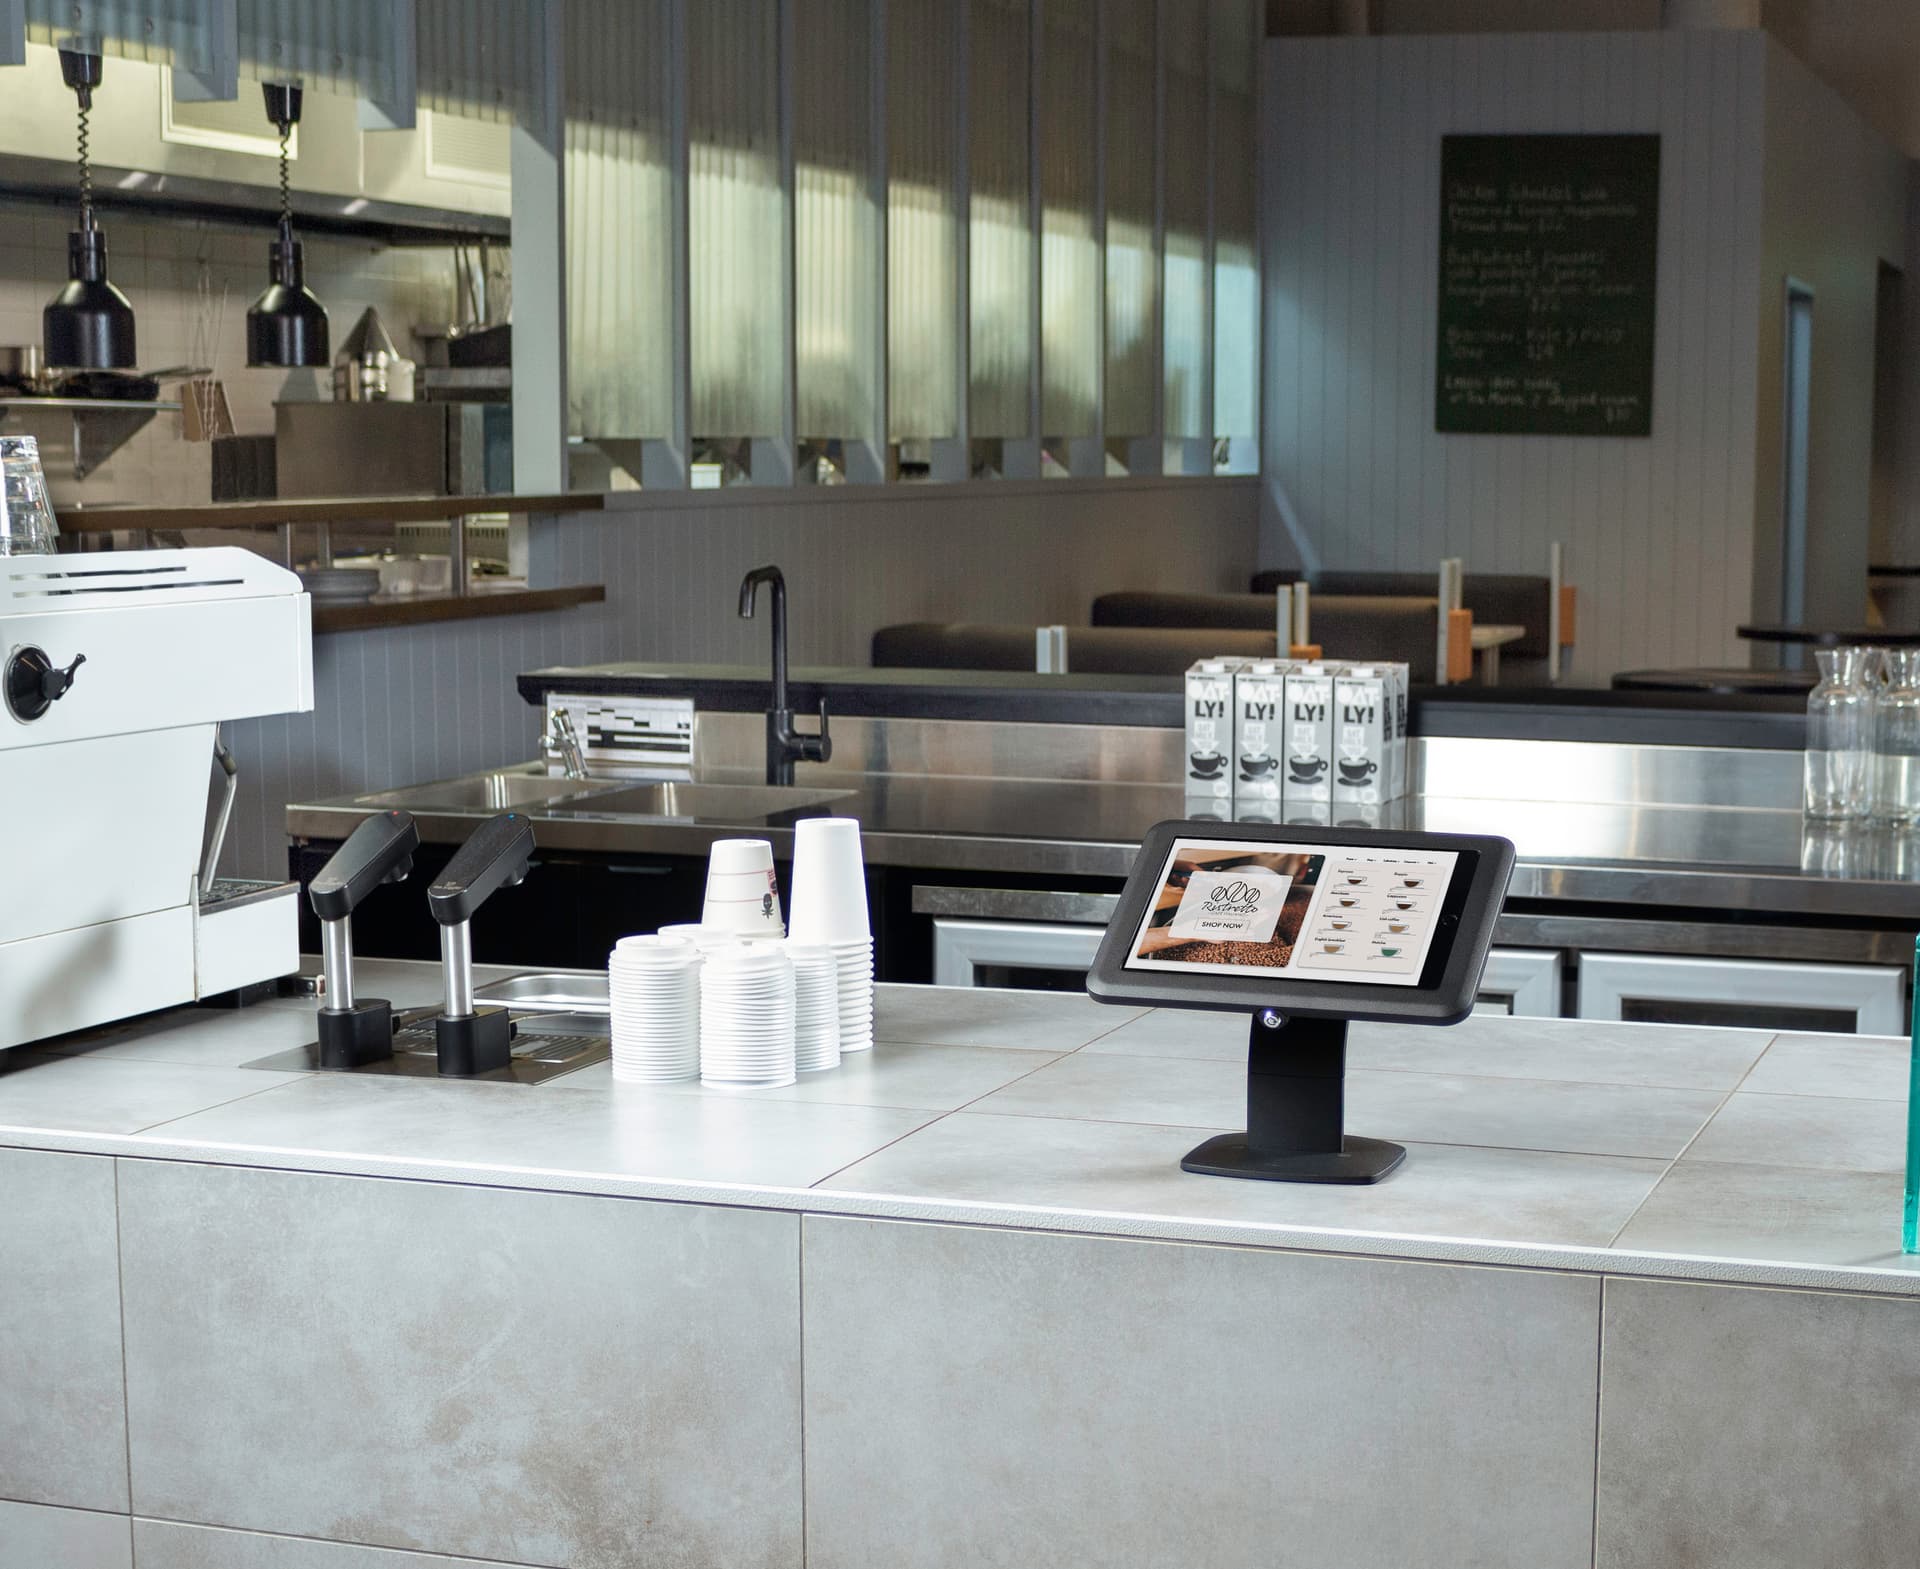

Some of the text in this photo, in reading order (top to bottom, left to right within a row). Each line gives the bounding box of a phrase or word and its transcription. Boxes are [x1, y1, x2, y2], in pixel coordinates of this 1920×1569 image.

[1194, 700, 1225, 718] LY!
[1245, 702, 1275, 720] LY!
[1294, 703, 1325, 722] LY!
[1343, 705, 1375, 724] LY!
[1201, 901, 1258, 914] Ristretto
